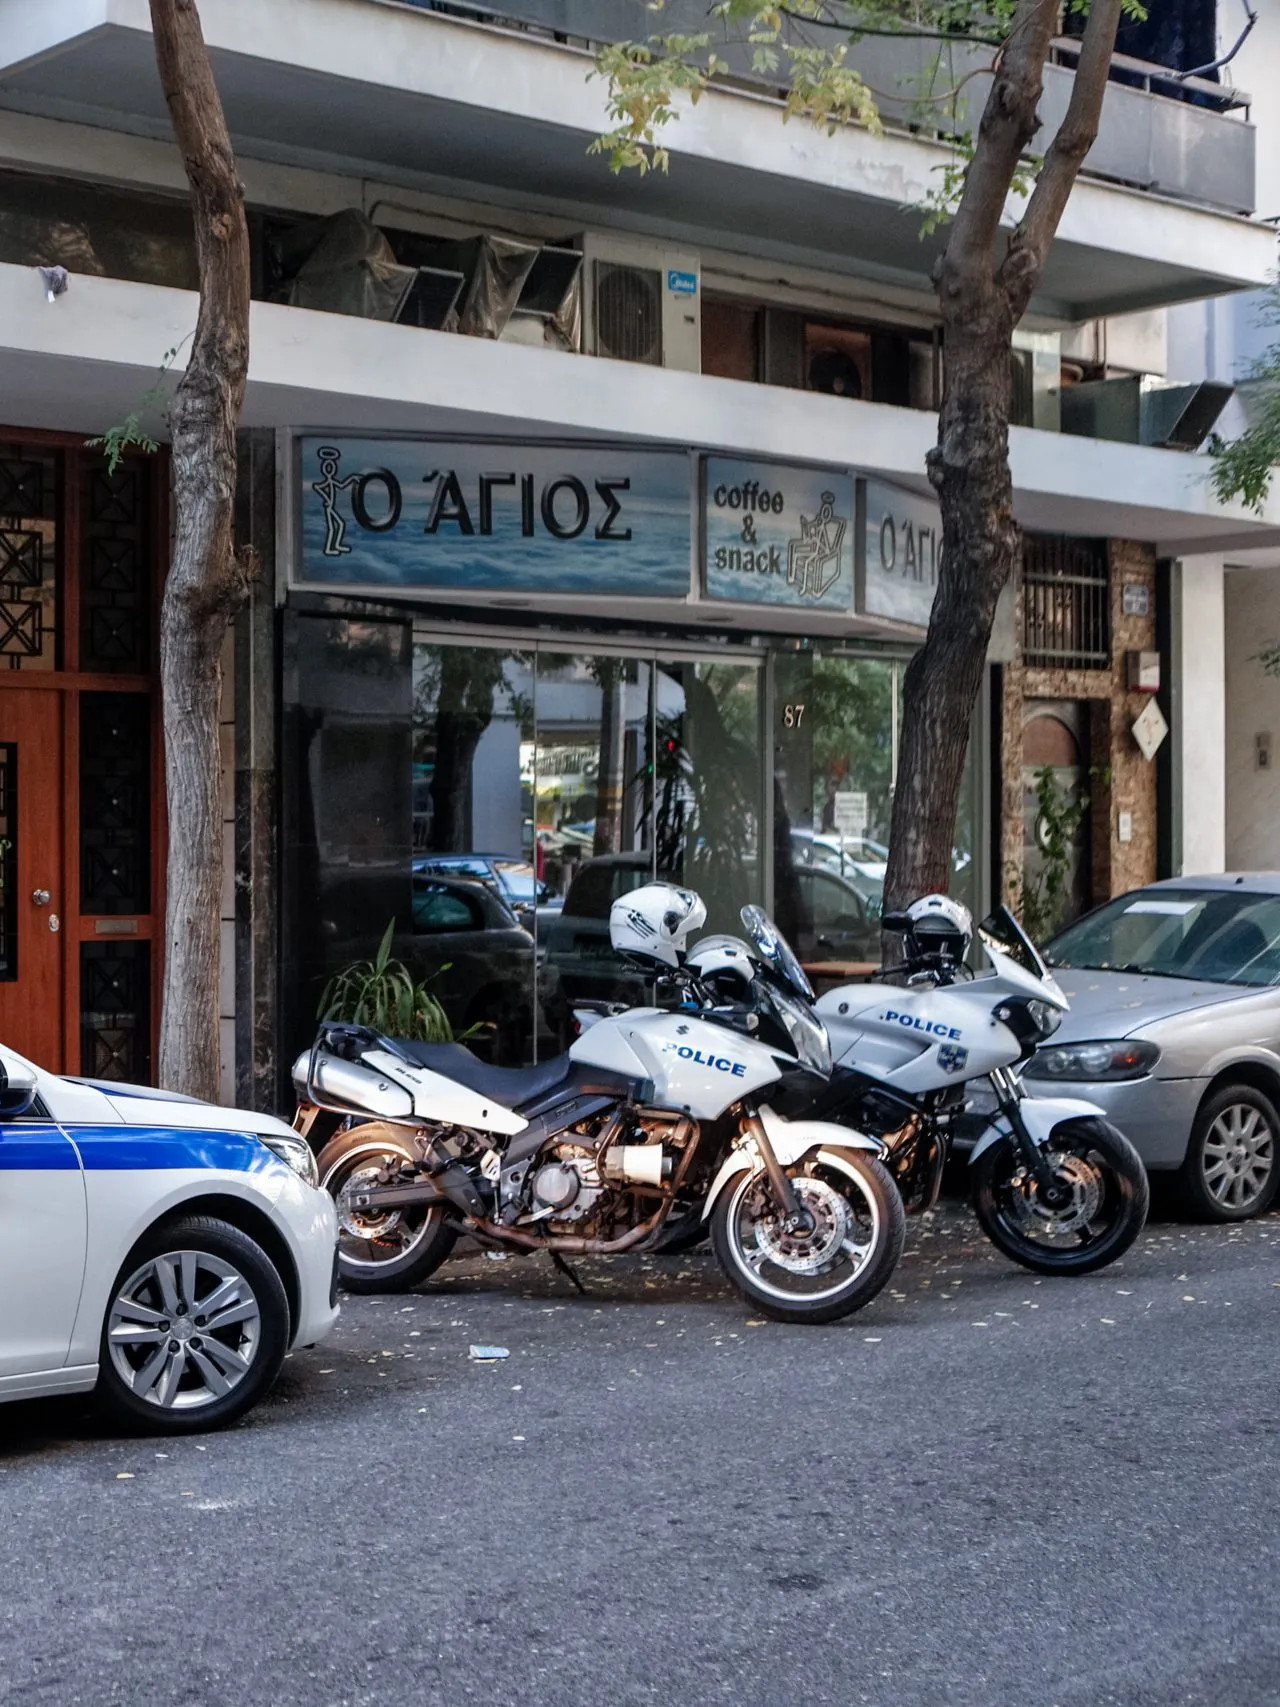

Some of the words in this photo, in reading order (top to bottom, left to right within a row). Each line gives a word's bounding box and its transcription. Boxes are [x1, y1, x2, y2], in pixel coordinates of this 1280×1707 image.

[351, 466, 402, 532] Ο
[714, 480, 784, 515] coffee
[741, 513, 757, 545] &
[714, 545, 782, 575] snack
[784, 705, 805, 728] 87
[885, 1010, 963, 1041] POLICE
